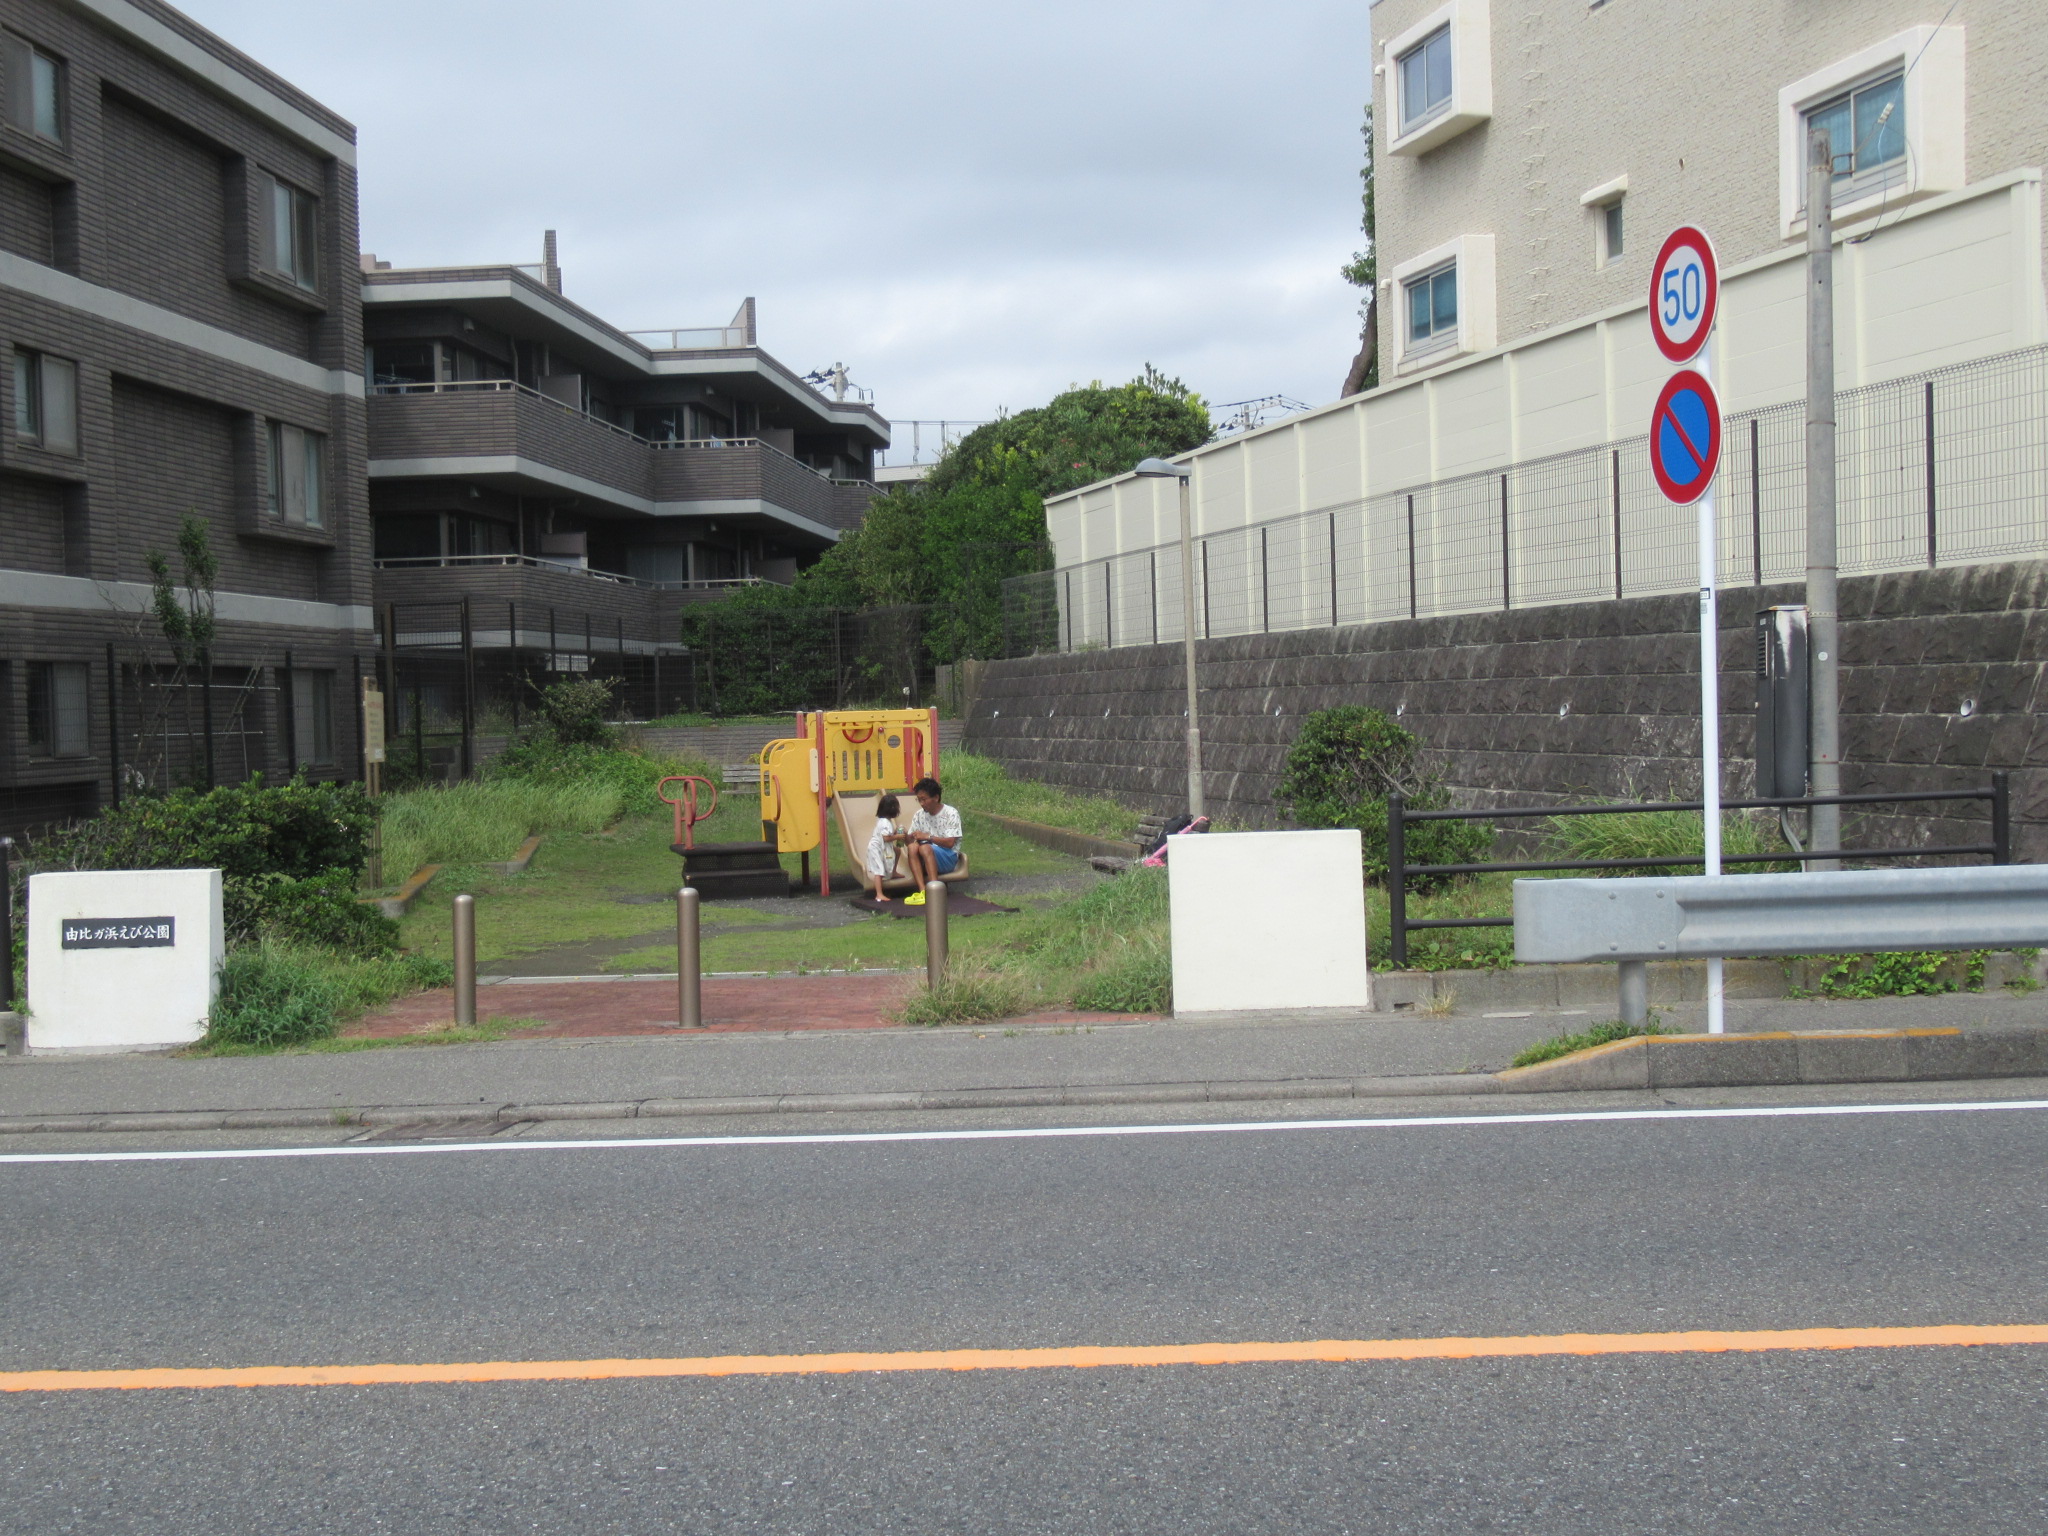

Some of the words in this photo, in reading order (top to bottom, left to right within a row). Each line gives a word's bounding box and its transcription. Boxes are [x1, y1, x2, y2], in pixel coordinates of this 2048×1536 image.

[1664, 263, 1700, 326] 50
[66, 924, 170, 941] 由比ガ浜えび公園
